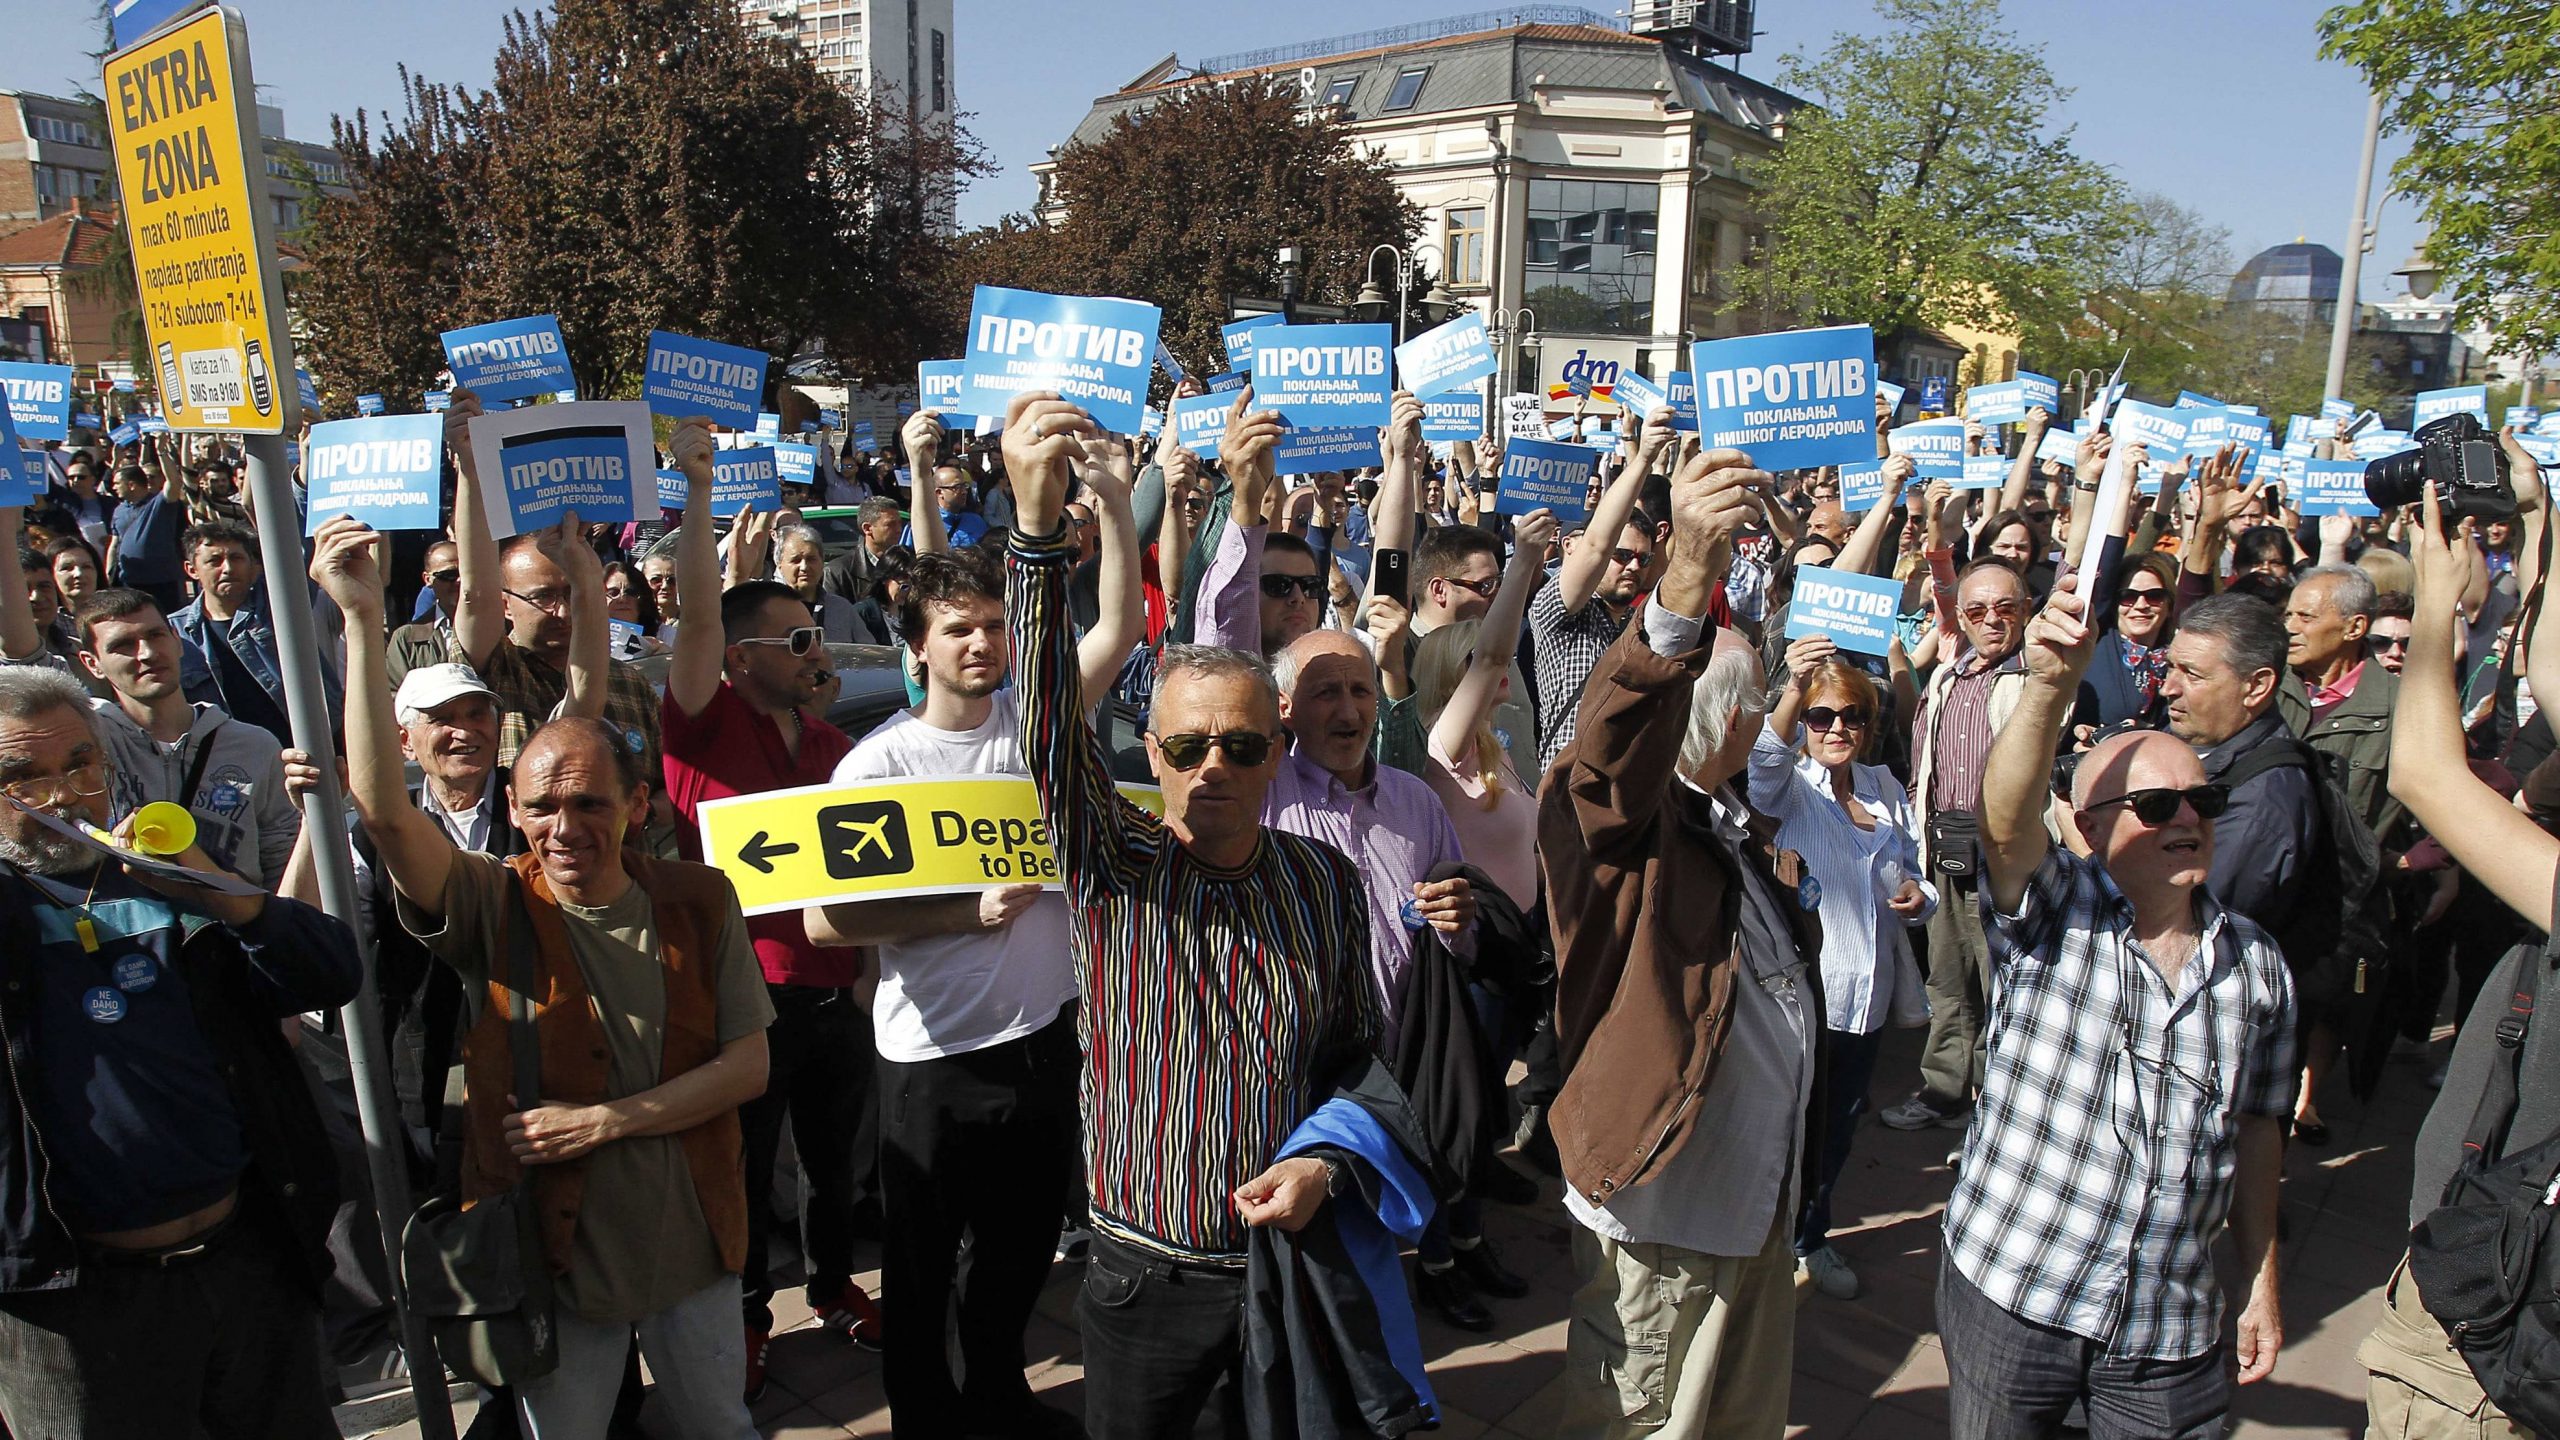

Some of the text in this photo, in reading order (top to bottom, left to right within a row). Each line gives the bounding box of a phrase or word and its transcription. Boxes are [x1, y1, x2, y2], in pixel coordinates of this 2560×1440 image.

[118, 40, 218, 133] EXTRA
[136, 126, 220, 204] ZONA
[140, 205, 230, 248] max 60 minuta
[145, 246, 247, 294] naplata parkiranja
[151, 289, 257, 329] 7-21 subotom 7-14
[451, 331, 559, 369] ПРОТИВ
[976, 315, 1144, 367] ПРОТИВ
[189, 356, 208, 375] karta
[209, 360, 219, 374] za
[480, 358, 543, 375] ПОКЛАЊАЊА
[652, 349, 758, 391] ПРОТИВ
[1006, 359, 1104, 382] ПОКЊАЊА
[1258, 346, 1385, 377] ПРОТИВ
[1562, 350, 1619, 383] dm
[463, 365, 564, 388] НИШКОГ АЕРОДРОМА
[1282, 379, 1359, 391] ПОКЛАЊАЊА
[1705, 358, 1866, 410] ПРОТИВ
[190, 382, 240, 402] SMS na 9180
[670, 378, 734, 399] ПОКЛАЊАЊА
[973, 374, 1133, 405] НИШКО ЕРОДРОМА
[649, 386, 751, 413] НИШКОГ АЕРОДРОМА
[1260, 392, 1382, 407] НИШКОГ АЕРОДРОМА
[1511, 398, 1540, 410] ЧИЈЕ
[2418, 395, 2481, 415] ПРОТИВ
[1180, 404, 1238, 432] ПРОТ
[1512, 411, 1529, 421] СУ
[1743, 404, 1838, 426] ПОКЛАЊАЊА
[1512, 423, 1542, 433] НАШЕ
[1713, 419, 1866, 448] НИШКОГ АЕРОДРОМА
[2132, 411, 2187, 441] РОТИВ
[1279, 441, 1373, 459] НИШКОГ АЕРОДРОМА
[1296, 433, 1354, 446] ПОКЛАЊАЊА
[312, 439, 432, 480] ПРОТИВ
[1507, 454, 1589, 485] ПРОТИВ
[511, 456, 624, 491] ПРОТИВ
[1845, 470, 1884, 488] ПРОТ
[2306, 472, 2366, 489] ПРОТИ
[329, 478, 404, 494] ПОКЛАЊАЊА
[536, 483, 604, 499] ПОКЛАЊАЊА
[728, 489, 775, 501] АЕРОДРОМА
[1503, 488, 1582, 505] НИШКОГ АЕРОДРОМА
[1522, 481, 1571, 495] ПОКЛАЊАЊА
[313, 492, 428, 512] НИШКОГ АЕРОДРОМА
[519, 494, 625, 515] НИШКОГ АЕРОДРОМА
[1796, 580, 1893, 617] ПРОТИВ
[1811, 607, 1869, 626] ПОКЛАЊАЊА
[1829, 621, 1885, 639] АЕРОДРОМА
[931, 810, 1049, 854] Depa
[979, 851, 1057, 878] to Be
[92, 999, 118, 1010] DAMO
[99, 990, 111, 1000] NE
